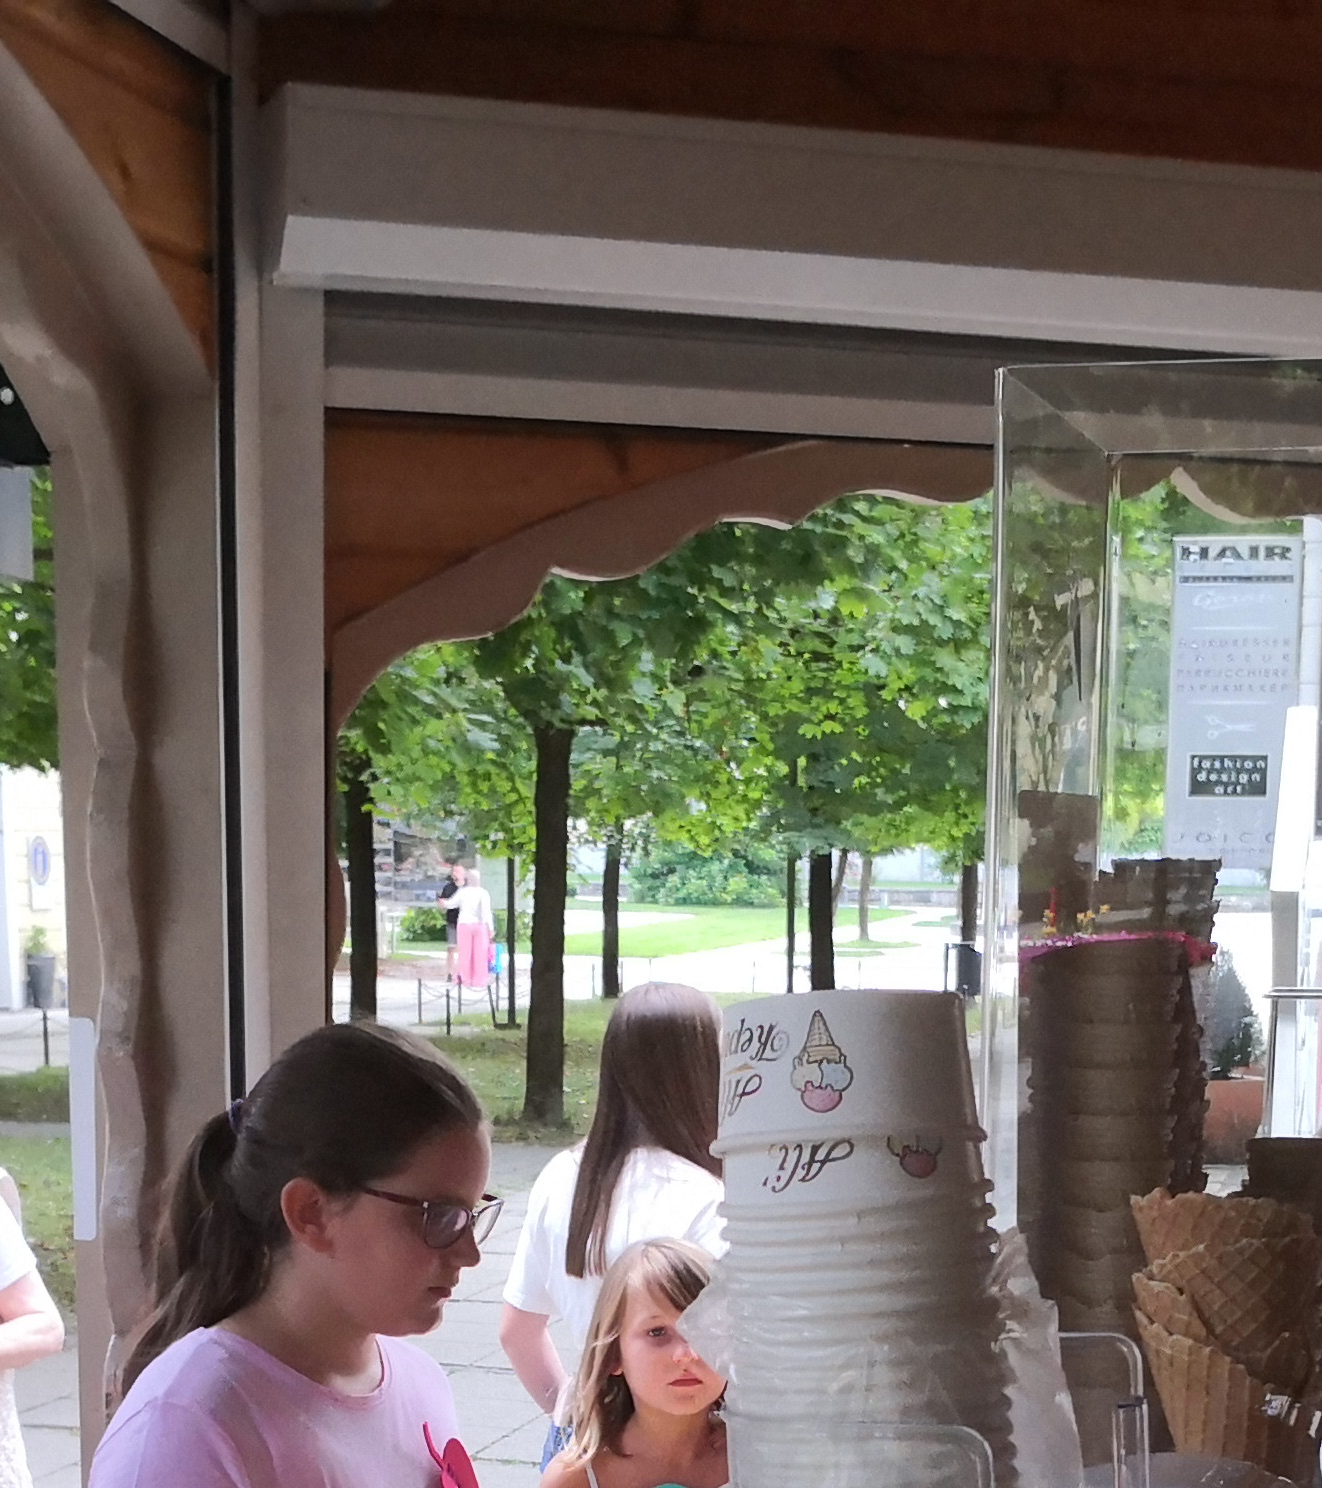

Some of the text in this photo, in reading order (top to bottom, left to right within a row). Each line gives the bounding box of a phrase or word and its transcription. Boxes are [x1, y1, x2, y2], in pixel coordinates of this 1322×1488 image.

[1180, 544, 1292, 561] HAIR
[1192, 757, 1266, 769] fashion
[1196, 770, 1261, 784] design
[1214, 785, 1243, 794] art
